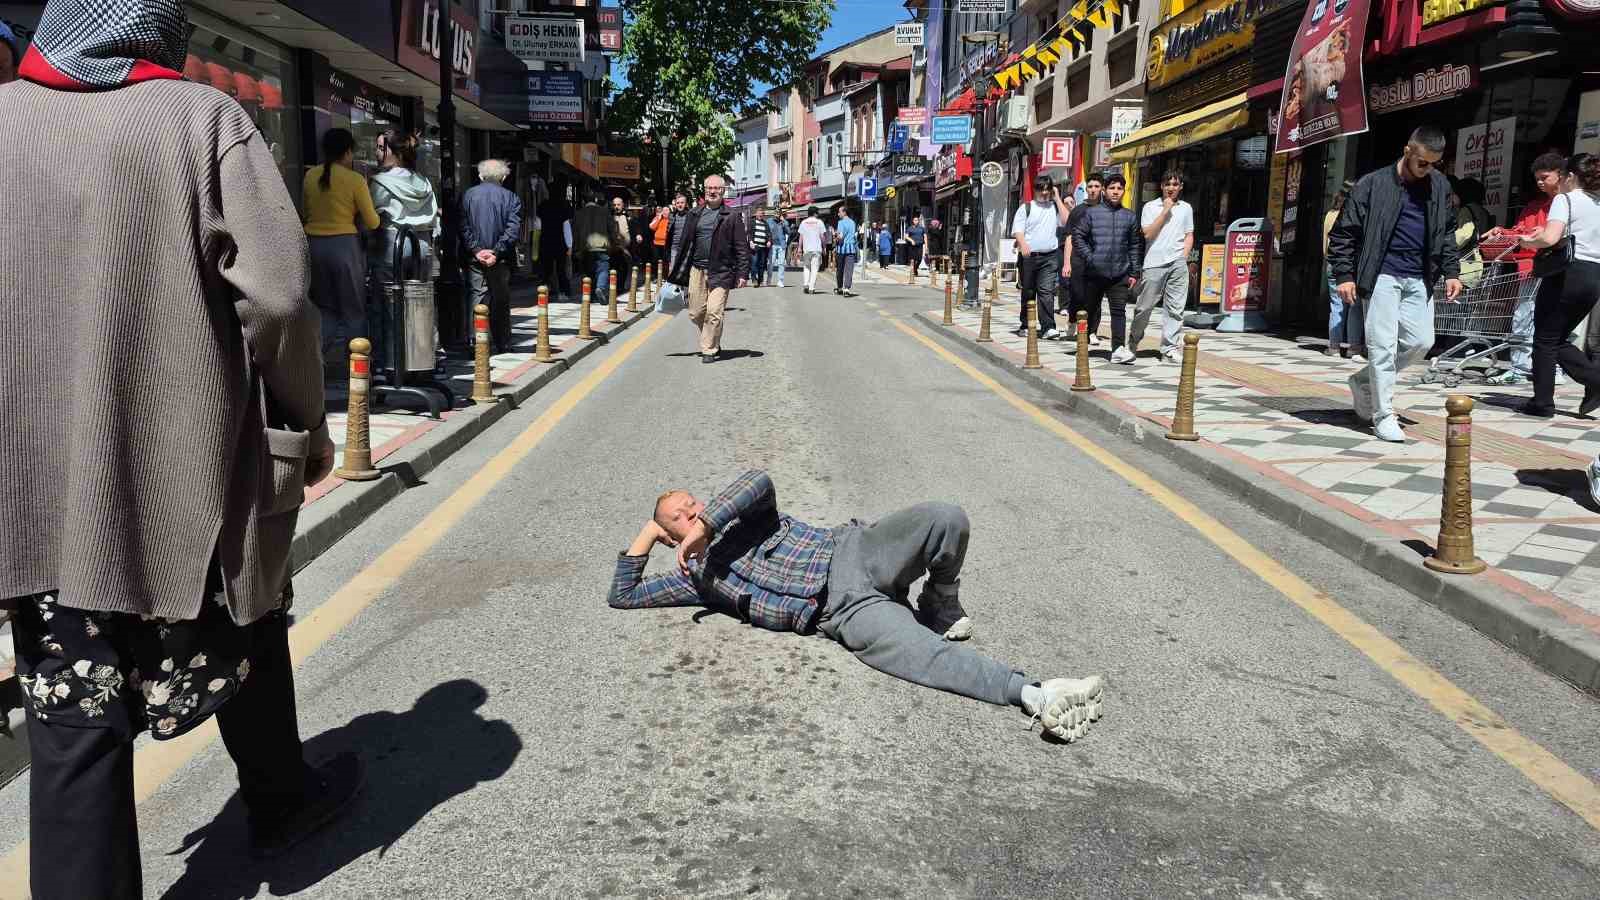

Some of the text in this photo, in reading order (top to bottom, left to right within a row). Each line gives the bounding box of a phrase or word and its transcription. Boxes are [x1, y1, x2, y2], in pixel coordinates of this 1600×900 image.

[422, 0, 473, 75] LOUS
[522, 22, 580, 39] DİŞ HEKİMİ
[897, 26, 921, 35] AVUKAT
[1371, 79, 1411, 106] Soslu
[1414, 64, 1470, 100] Dürüm
[862, 180, 873, 197] P
